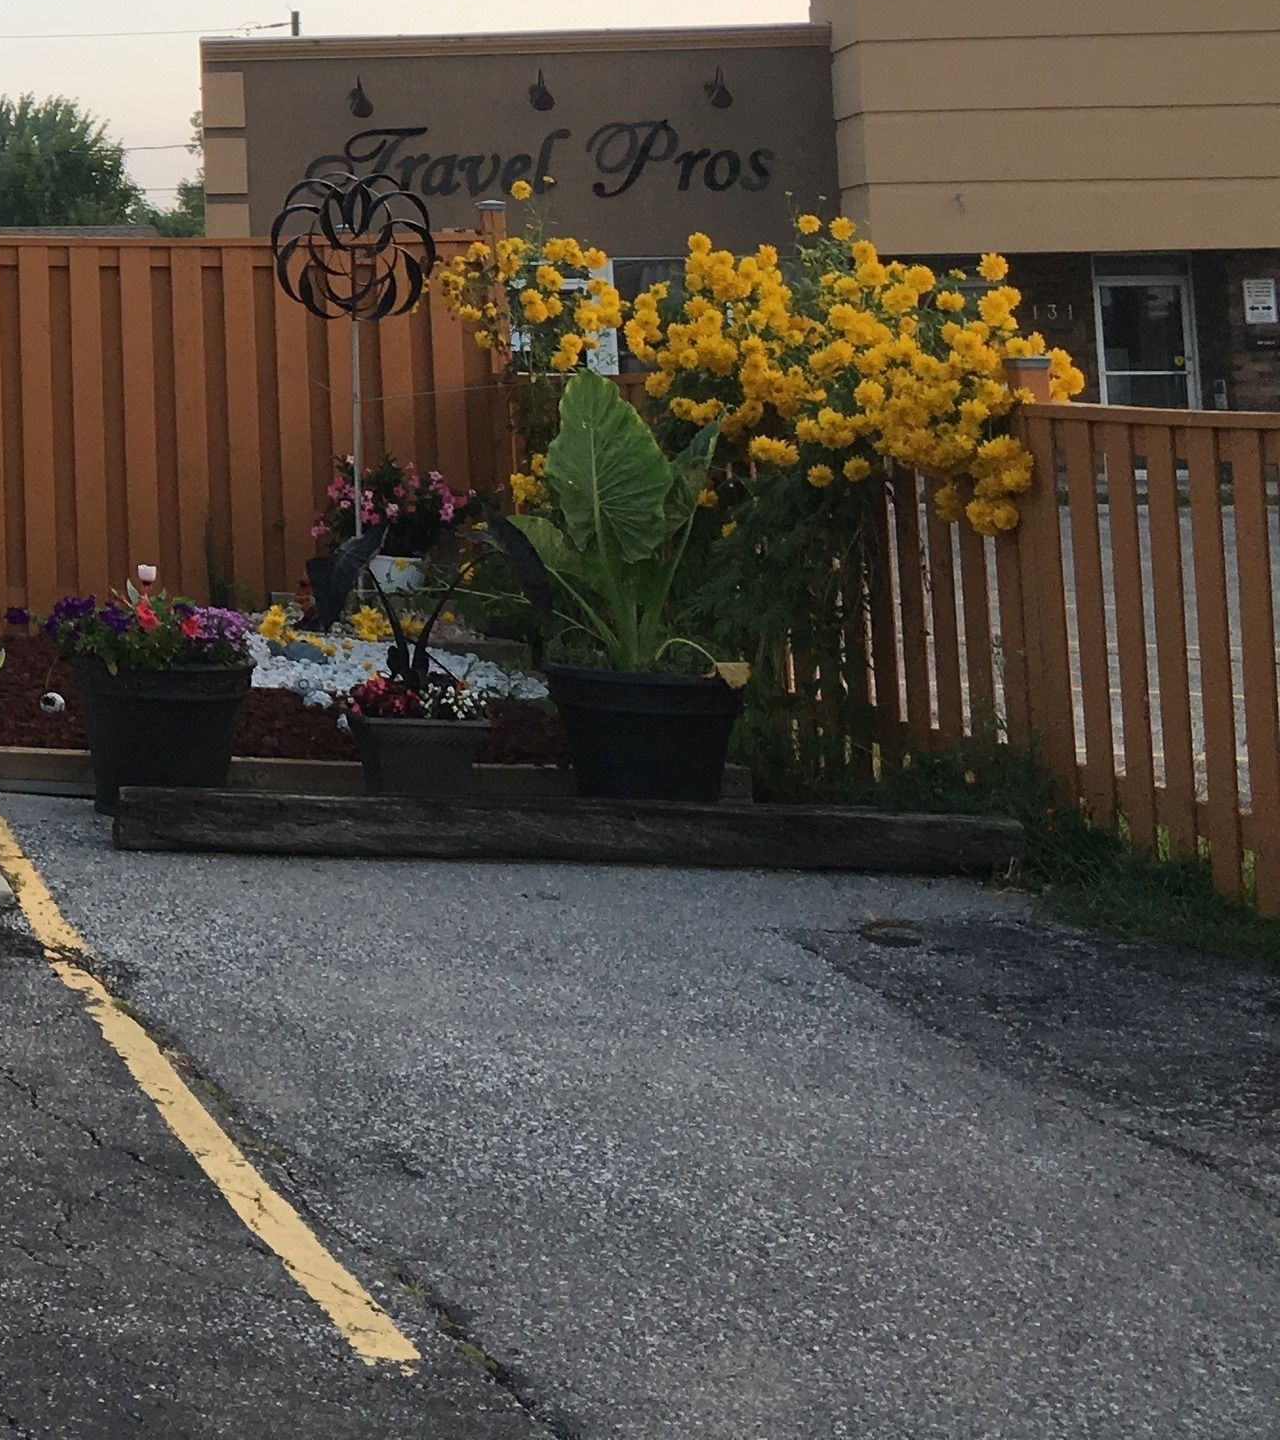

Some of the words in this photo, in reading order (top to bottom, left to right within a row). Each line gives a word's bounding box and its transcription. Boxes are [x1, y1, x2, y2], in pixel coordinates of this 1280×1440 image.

[304, 126, 571, 198] Travel
[585, 118, 776, 199] Pros
[1032, 304, 1073, 320] 131
